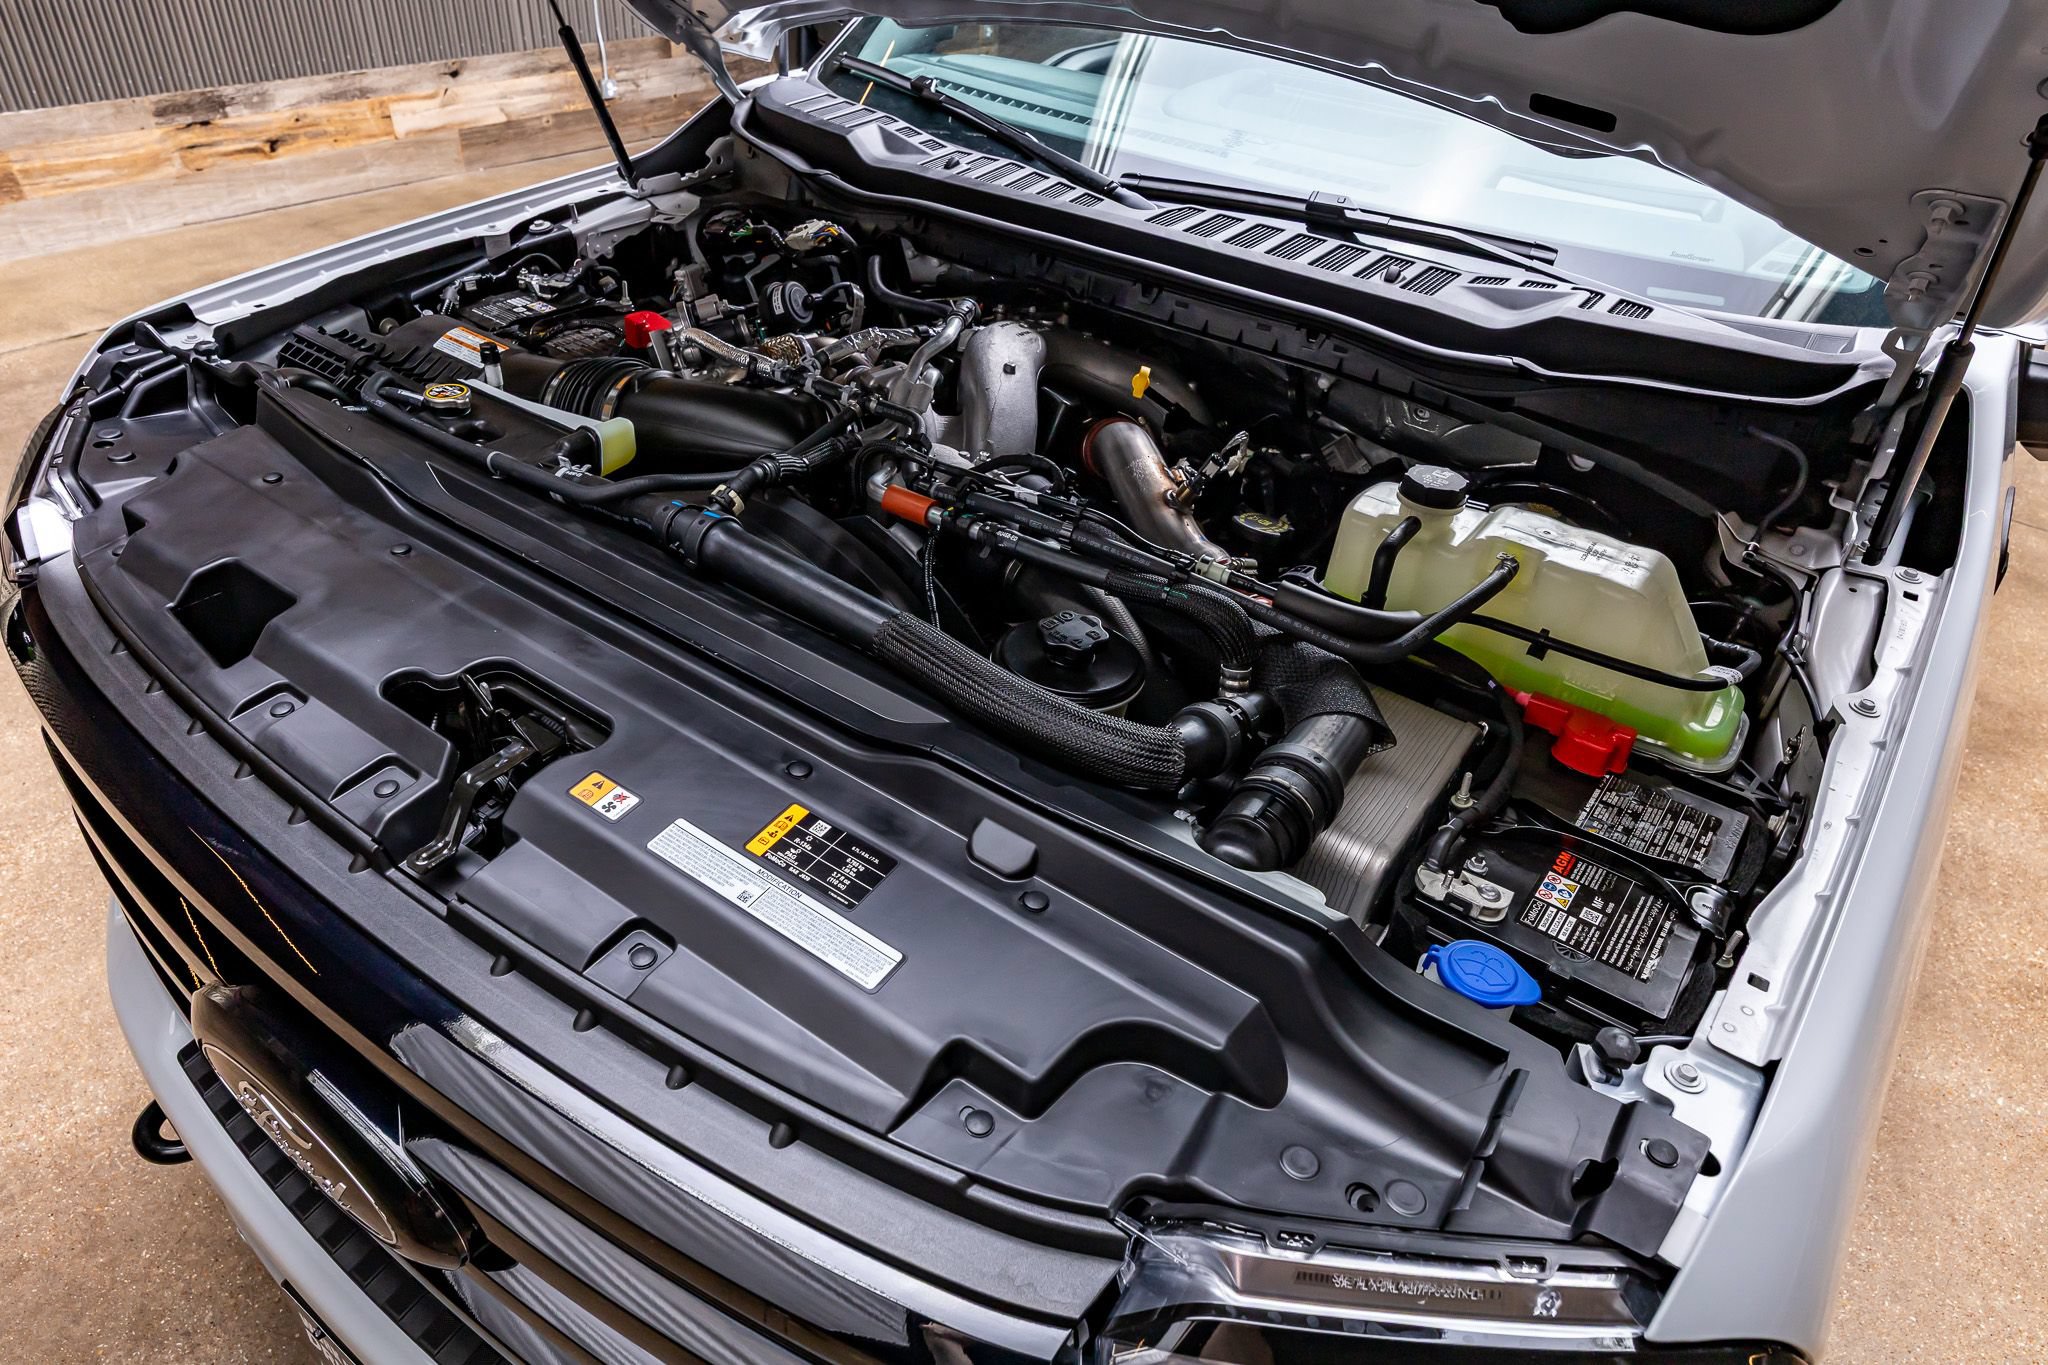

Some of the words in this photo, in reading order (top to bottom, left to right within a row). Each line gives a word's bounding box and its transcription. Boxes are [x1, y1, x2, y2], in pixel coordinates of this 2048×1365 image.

[793, 837, 812, 851] R-134a
[784, 850, 797, 860] PAG
[1552, 851, 1572, 873] AGM
[764, 852, 789, 868] FoMoCo
[788, 866, 801, 875] SAE
[831, 871, 841, 879] 3.7
[757, 868, 803, 899] MODIFICATION
[826, 876, 839, 885] (110
[837, 883, 847, 891] cc)
[1591, 896, 1604, 910] MF
[1523, 901, 1543, 925] FoMoCo
